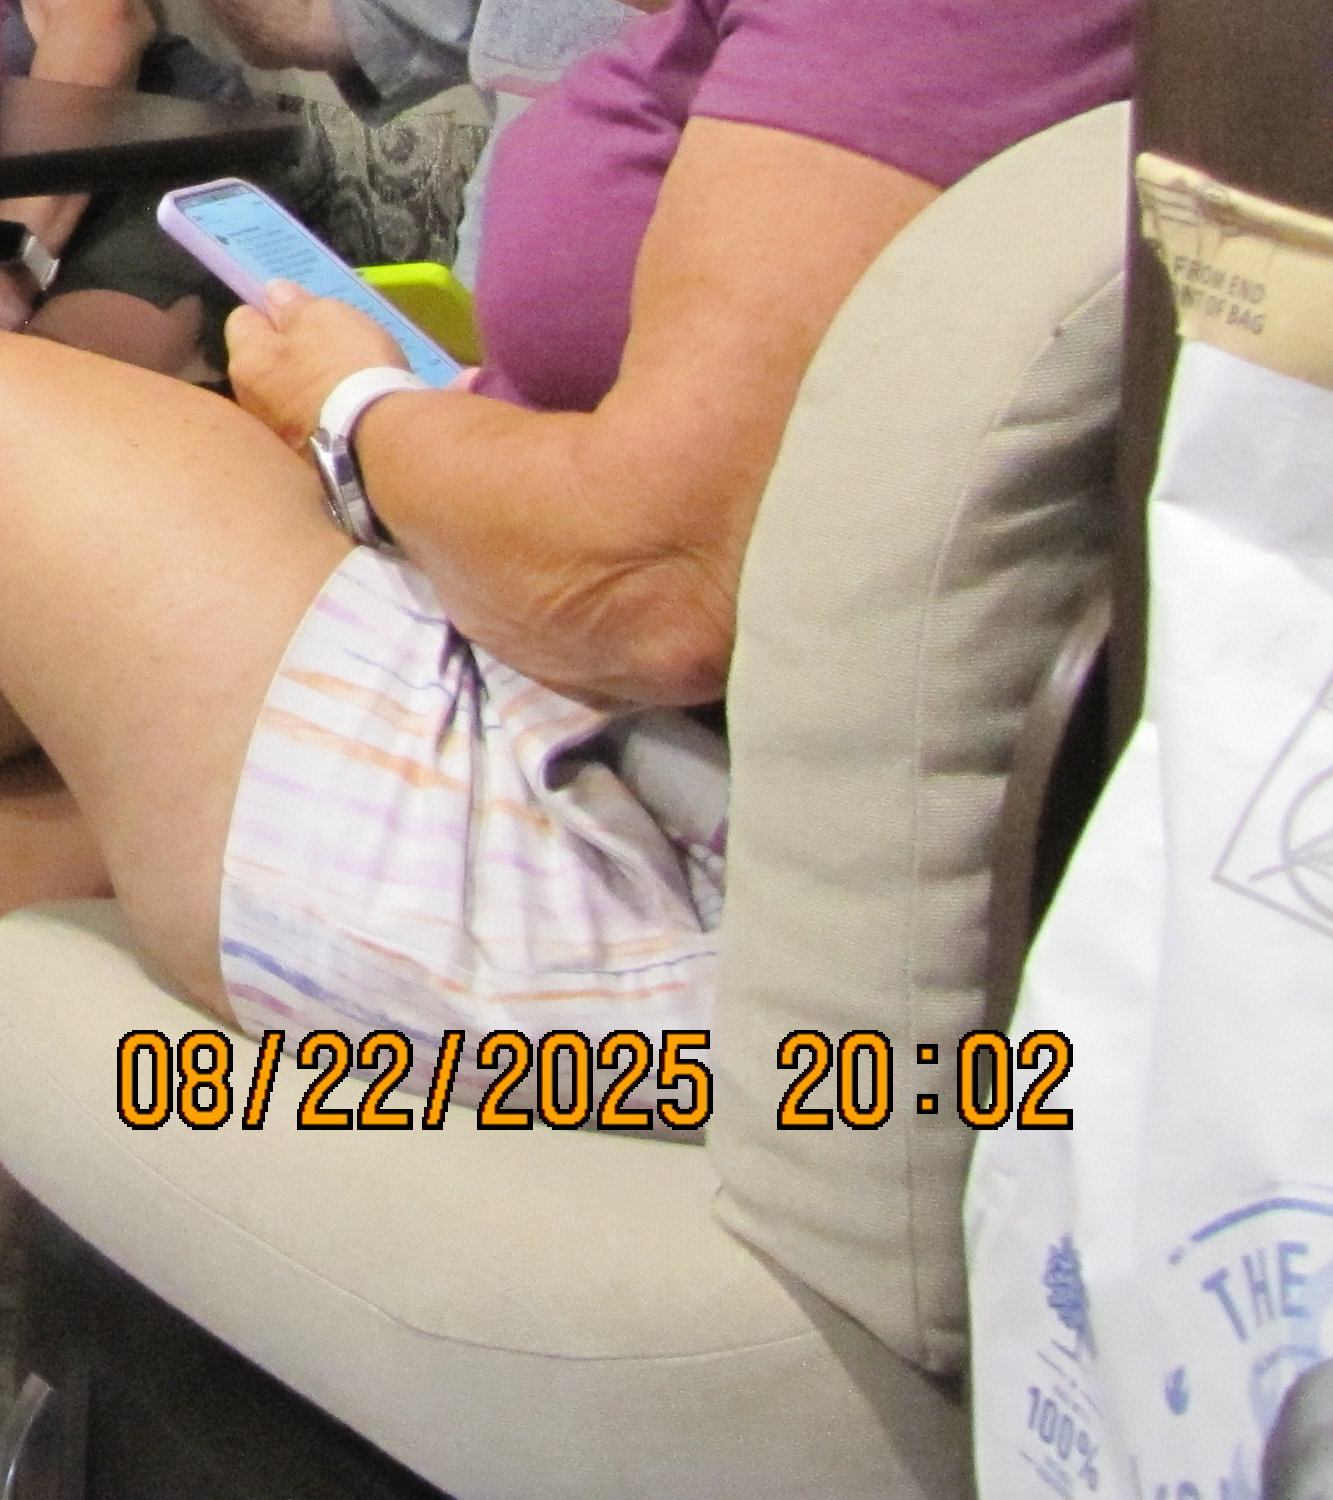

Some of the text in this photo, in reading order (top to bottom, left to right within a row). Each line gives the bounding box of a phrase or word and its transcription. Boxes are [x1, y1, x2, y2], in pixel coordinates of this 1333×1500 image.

[1226, 303, 1267, 336] BAG
[1229, 274, 1266, 305] END
[1200, 1241, 1310, 1343] THE
[1027, 1386, 1100, 1492] 100%
